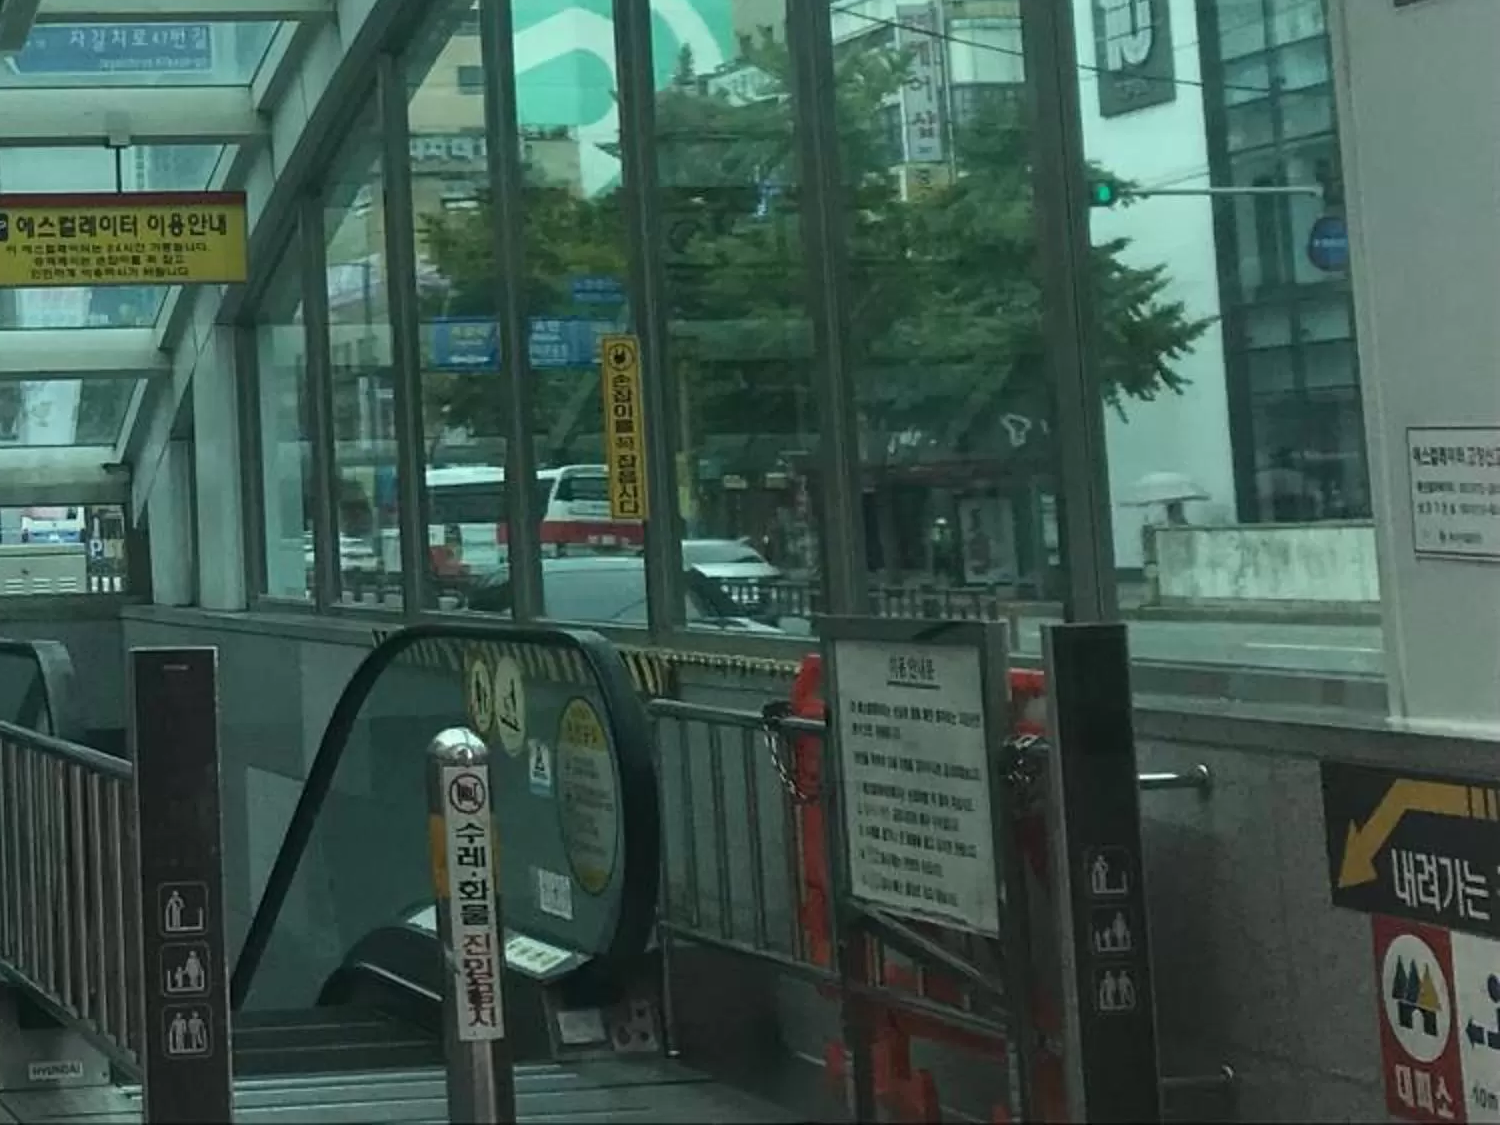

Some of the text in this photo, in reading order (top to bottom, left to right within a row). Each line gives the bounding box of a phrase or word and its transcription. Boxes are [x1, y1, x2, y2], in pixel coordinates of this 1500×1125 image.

[15, 211, 228, 239] 에스컬레이터 이용안내
[1390, 847, 1491, 921] 내려가는
[1394, 1062, 1456, 1120] 대피소
